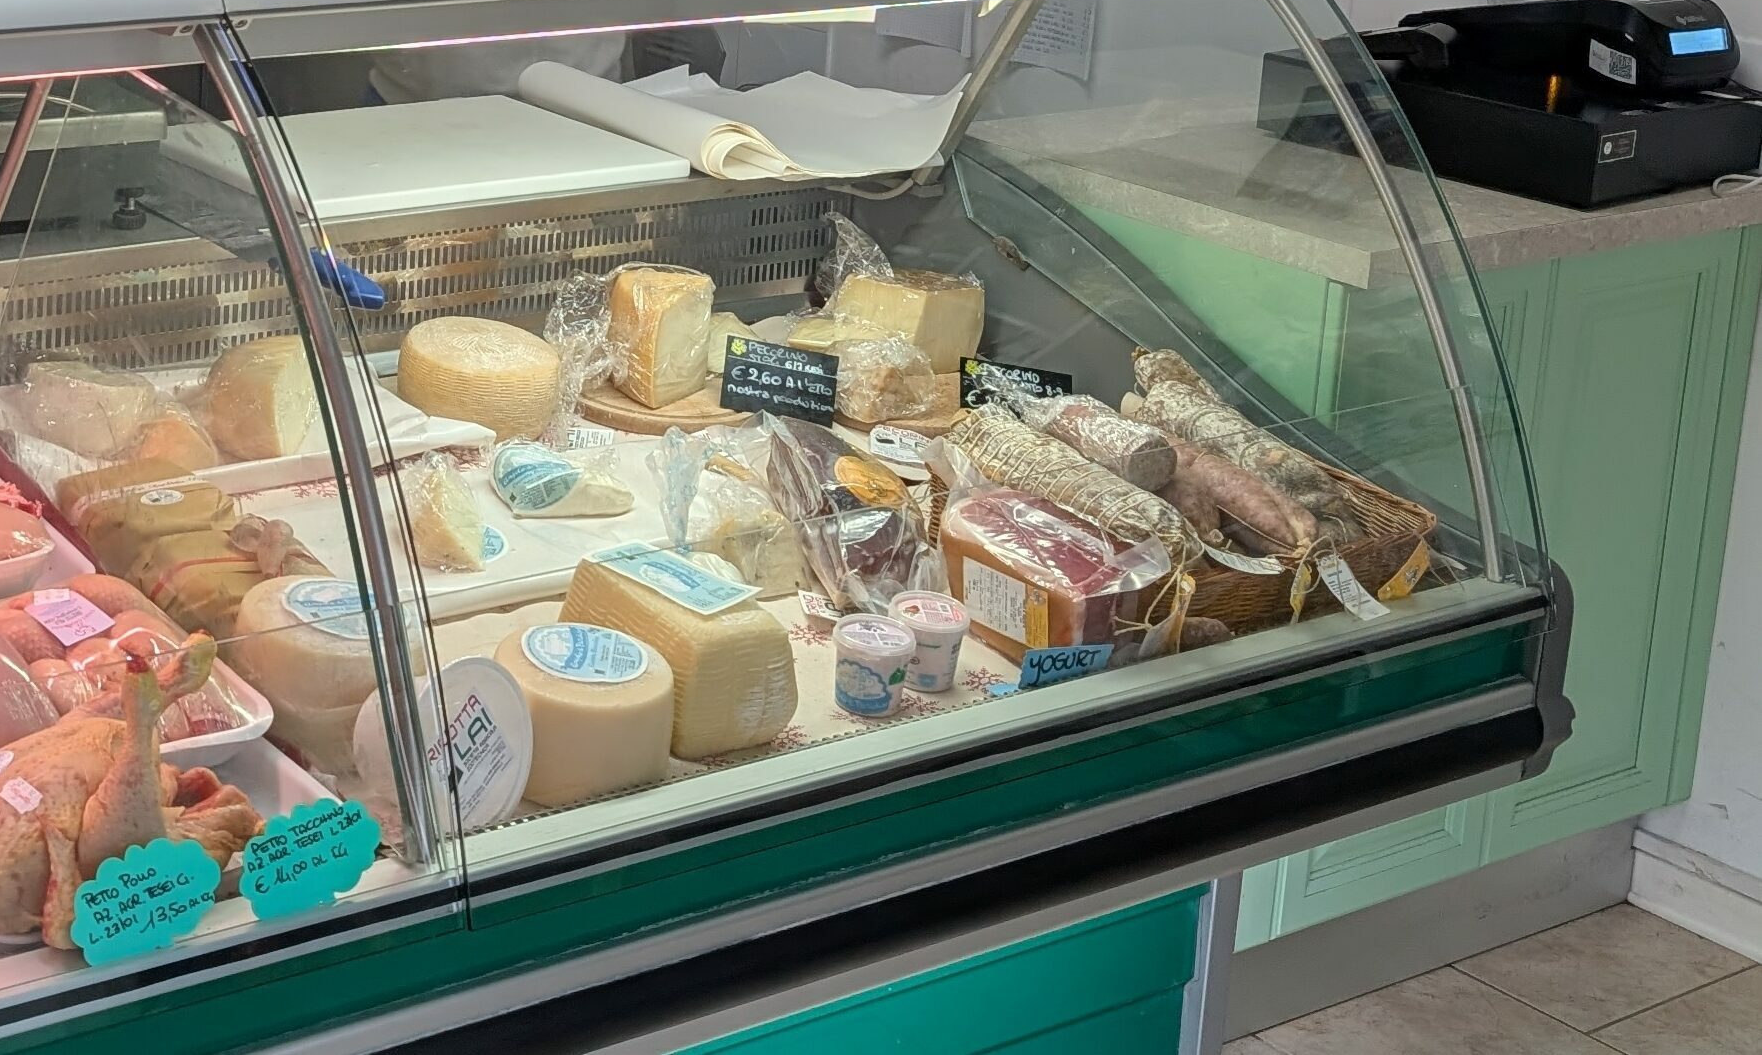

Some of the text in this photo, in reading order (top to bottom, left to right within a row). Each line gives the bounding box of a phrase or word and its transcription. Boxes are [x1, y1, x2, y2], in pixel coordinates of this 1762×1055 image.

[749, 341, 808, 363] PECORINO
[731, 366, 782, 385] € 2,60
[1030, 649, 1102, 674] YOGURT
[453, 707, 493, 760] LAI
[251, 806, 344, 856] PETTO TACCHINO
[268, 847, 295, 863] AGR.
[293, 831, 324, 849] TESEI
[82, 867, 157, 908] PETTO POLLO
[255, 875, 270, 893] €
[274, 861, 308, 885] 14,00
[312, 854, 328, 867] AL
[119, 894, 146, 914] AGR.
[143, 880, 176, 899] TESEI
[140, 902, 187, 933] 13,50
[189, 898, 200, 908] AL
